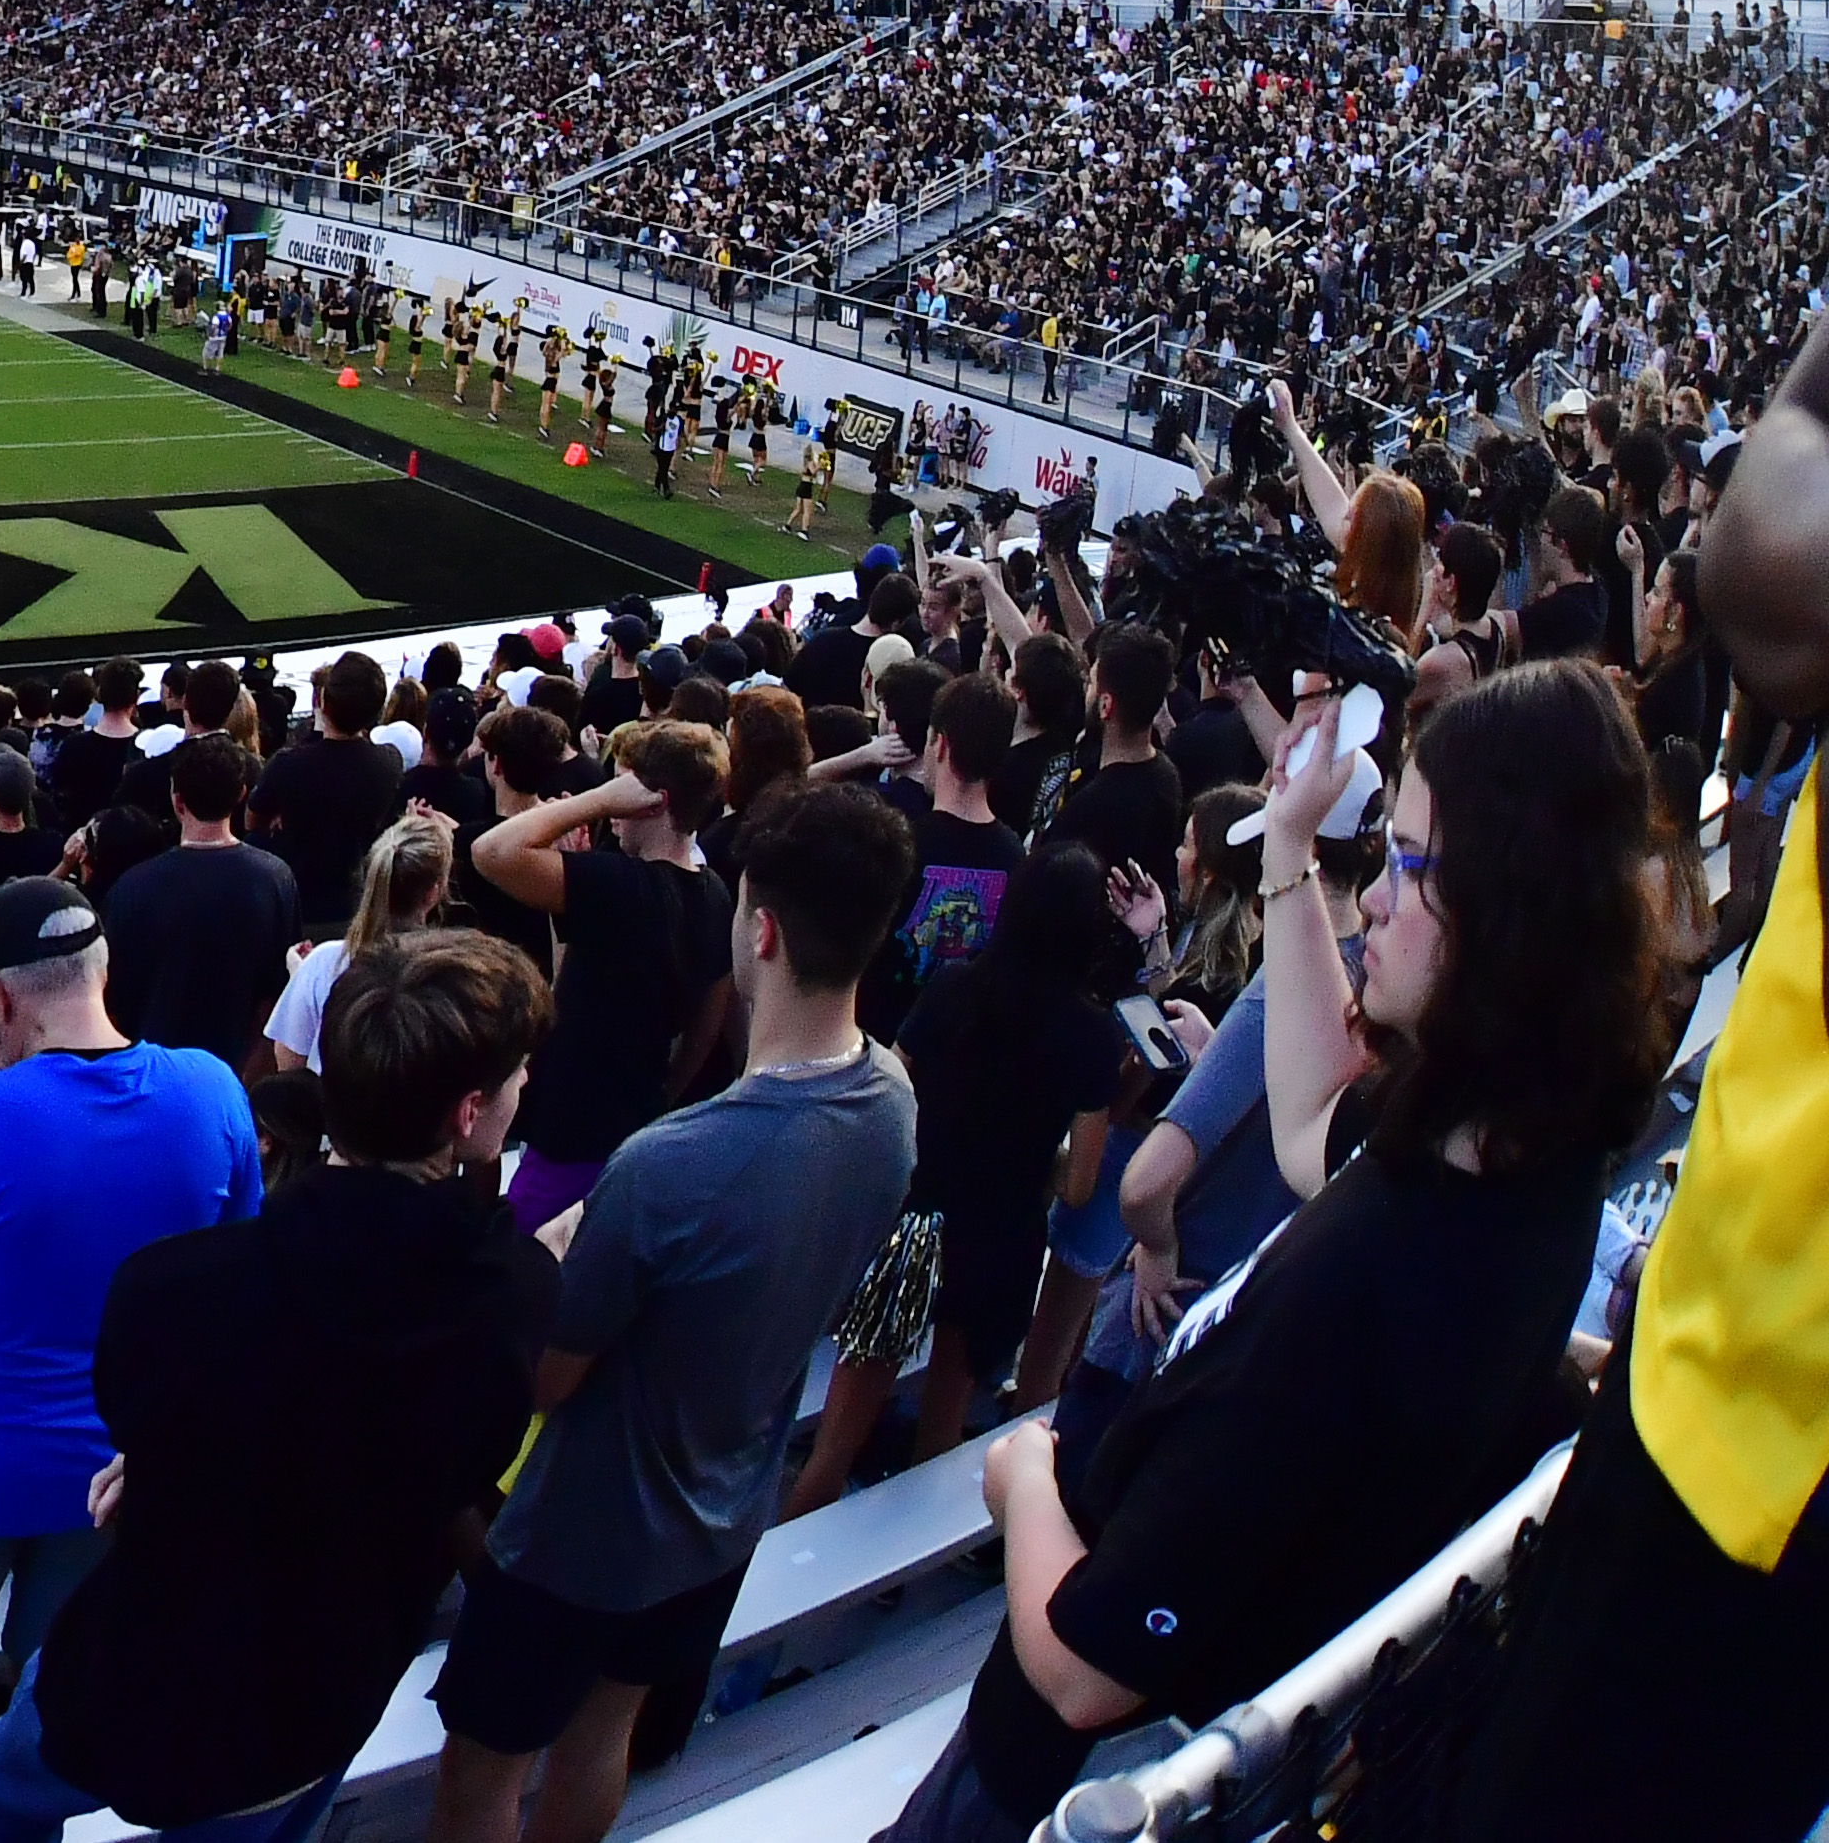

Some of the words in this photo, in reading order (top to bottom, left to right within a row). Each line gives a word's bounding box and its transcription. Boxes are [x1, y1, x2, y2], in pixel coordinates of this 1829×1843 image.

[288, 240, 328, 266] COLLEGE
[316, 223, 333, 244] THE
[333, 228, 372, 253] FUTURE
[373, 235, 387, 256] OF
[841, 305, 858, 329] 114
[732, 345, 784, 387] DEX
[843, 406, 894, 450] UCF
[1036, 455, 1082, 496] Waw
